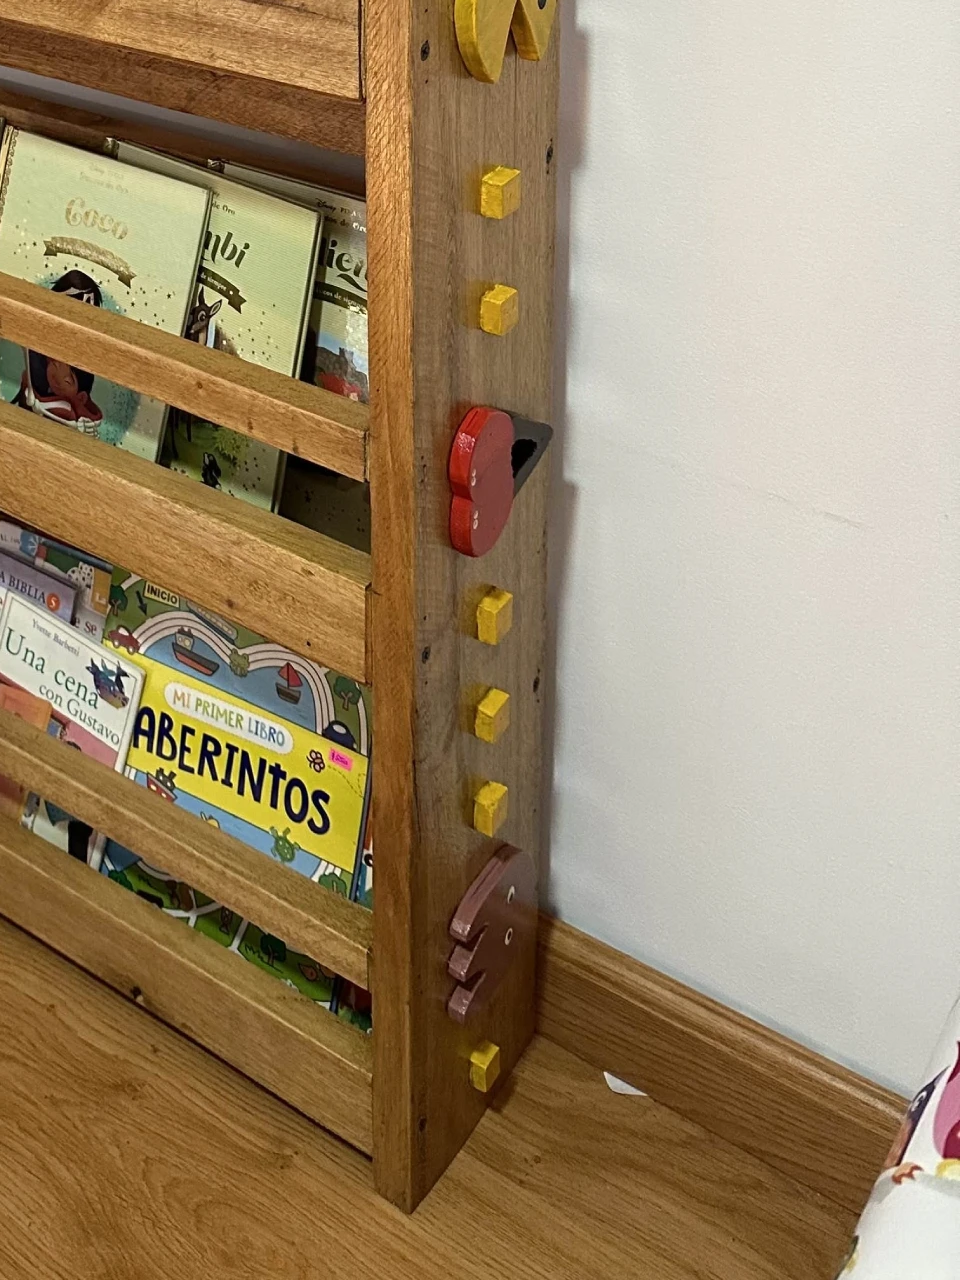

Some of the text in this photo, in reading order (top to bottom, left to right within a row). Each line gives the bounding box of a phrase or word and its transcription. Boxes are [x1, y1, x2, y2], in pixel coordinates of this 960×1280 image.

[65, 196, 129, 240] Coco
[222, 203, 236, 215] Oro
[8, 573, 47, 604] BIBLIA
[146, 584, 178, 606] INICIO
[5, 626, 99, 710] Una cena
[39, 683, 120, 746] con Gustavo
[172, 688, 286, 746] MI PRIMER LIBRO
